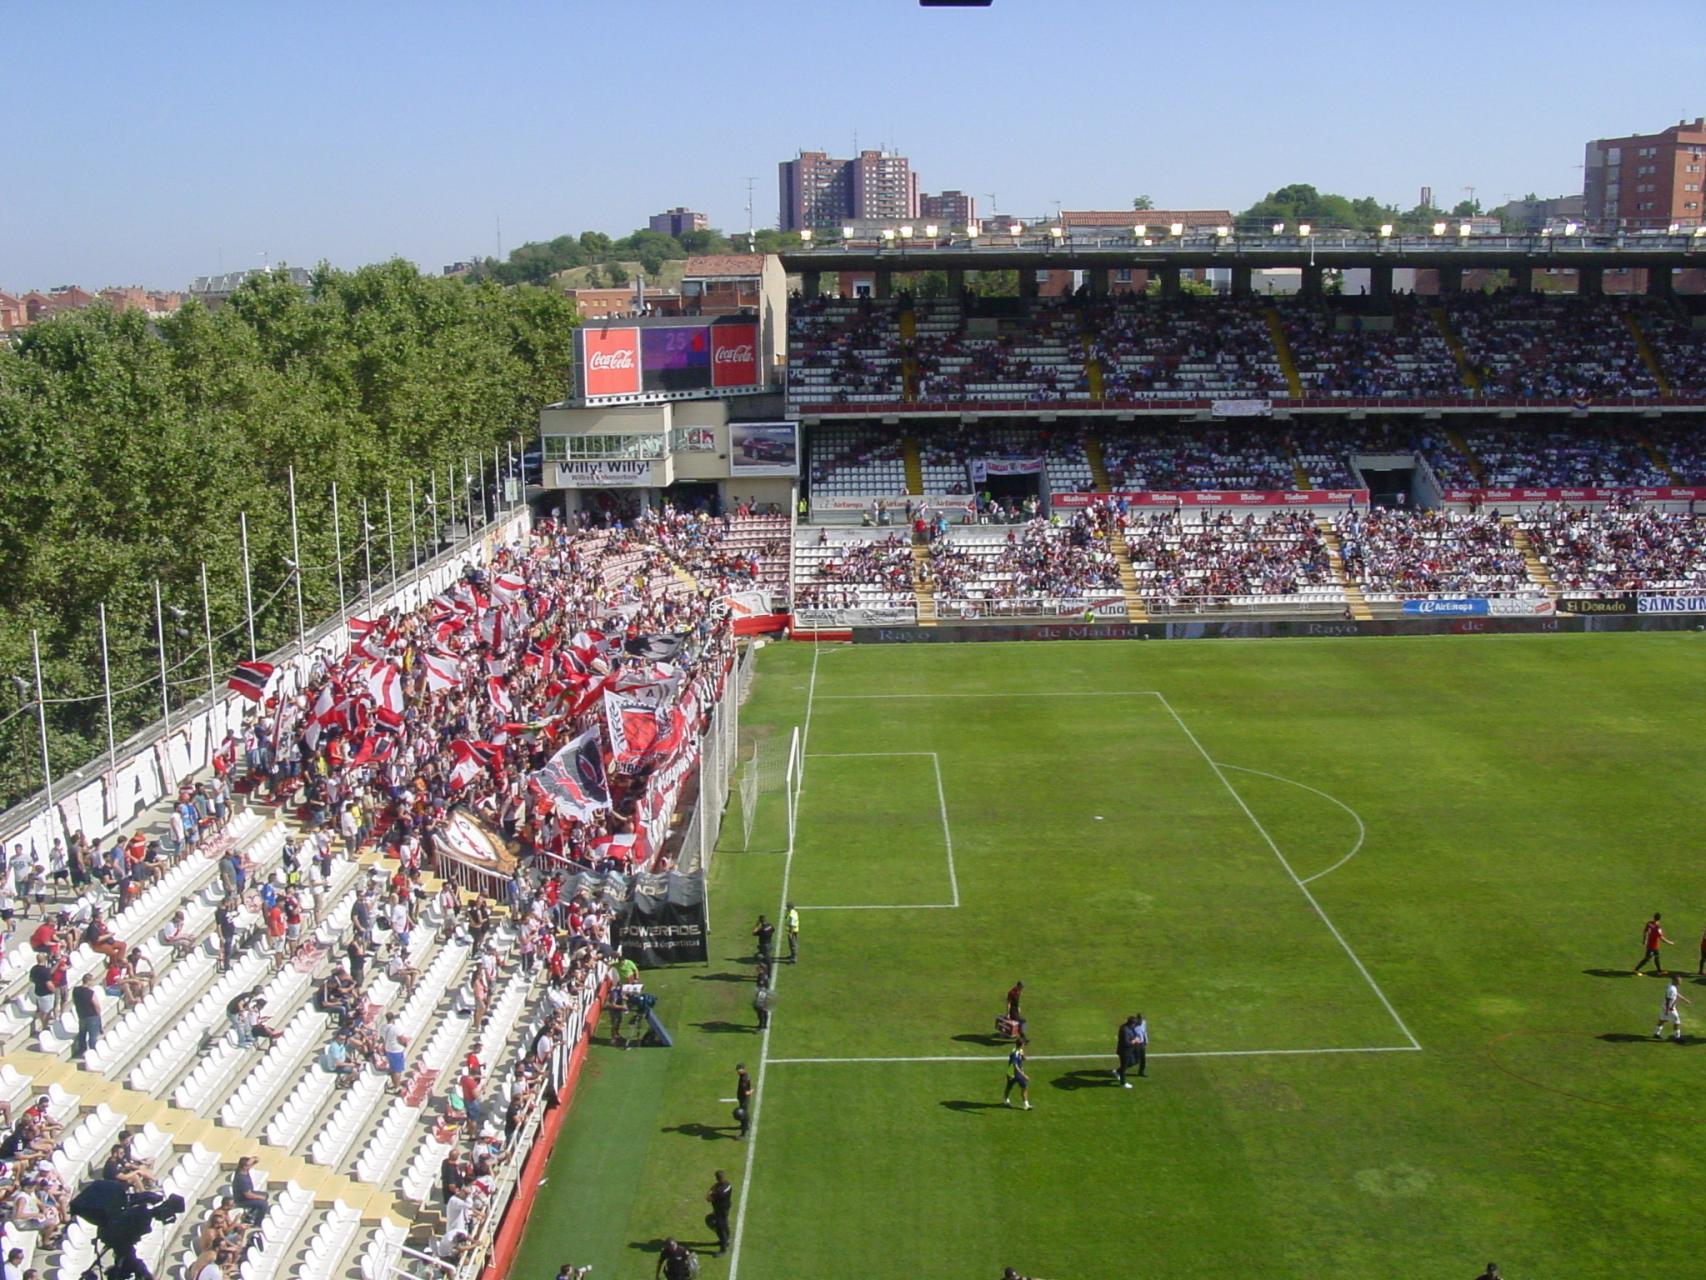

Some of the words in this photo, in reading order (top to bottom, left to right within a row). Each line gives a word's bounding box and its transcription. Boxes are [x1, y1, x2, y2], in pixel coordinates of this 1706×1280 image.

[590, 350, 634, 370] Coca-Cola
[560, 461, 602, 474] Willy!
[608, 461, 650, 474] Willy!
[880, 629, 930, 641] Rayo
[1037, 627, 1061, 638] de
[1069, 626, 1138, 638] Madrid
[1308, 624, 1359, 635] Rayo
[619, 925, 702, 937] POWERADE
